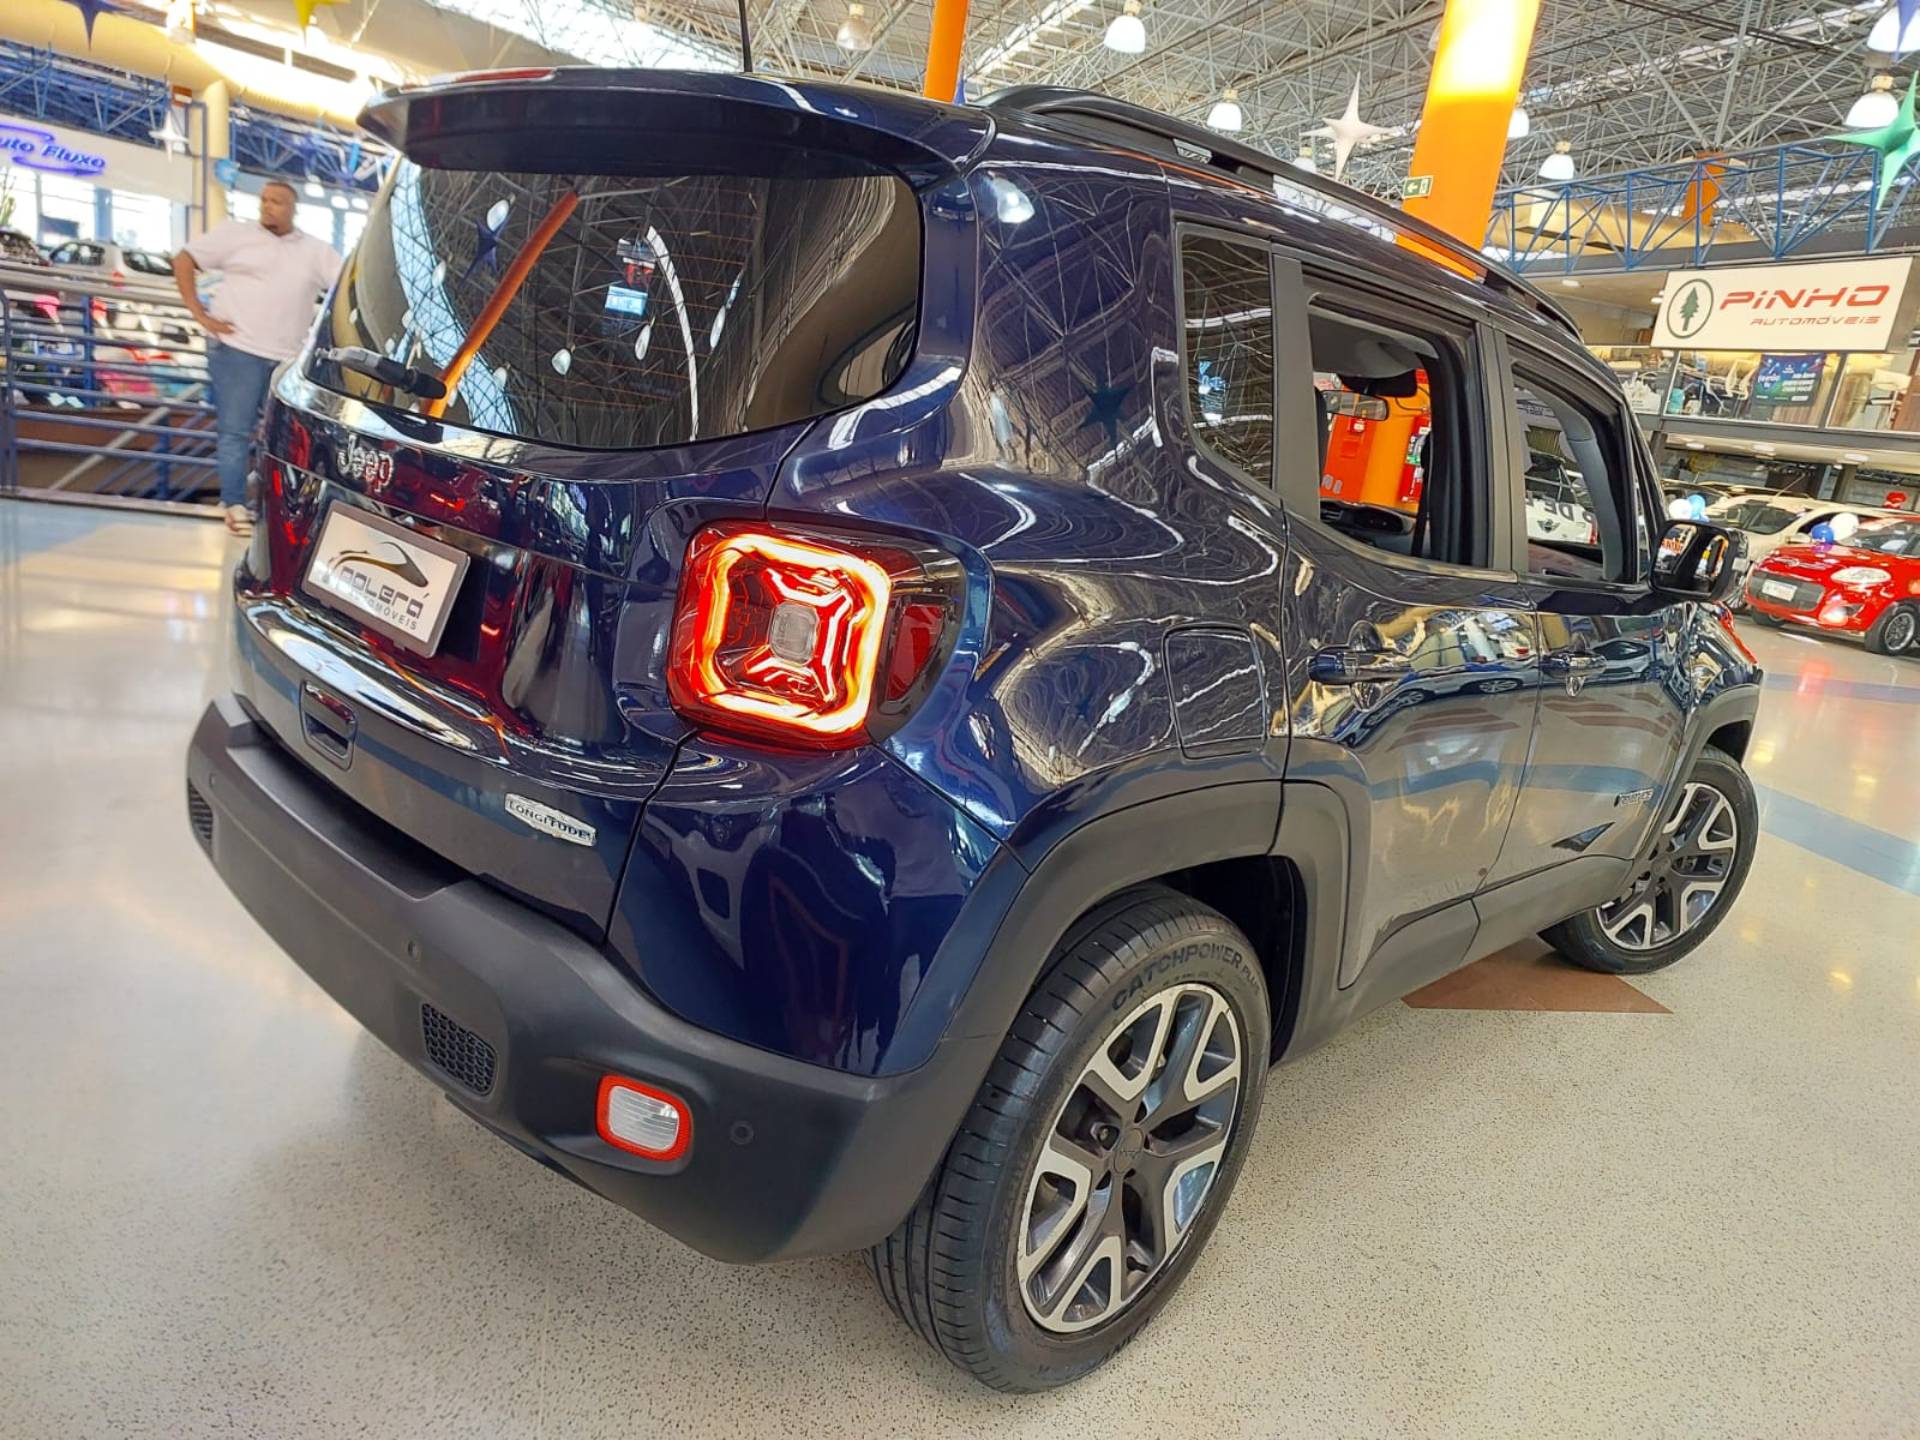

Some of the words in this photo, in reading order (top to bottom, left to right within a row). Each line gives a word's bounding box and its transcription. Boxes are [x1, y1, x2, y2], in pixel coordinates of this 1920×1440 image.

[0, 137, 34, 153] uto
[42, 144, 106, 168] Fluxo
[337, 433, 394, 493] Jeep
[508, 799, 591, 840] LONGITUDE
[1112, 942, 1243, 1011] CATCHPOWER
